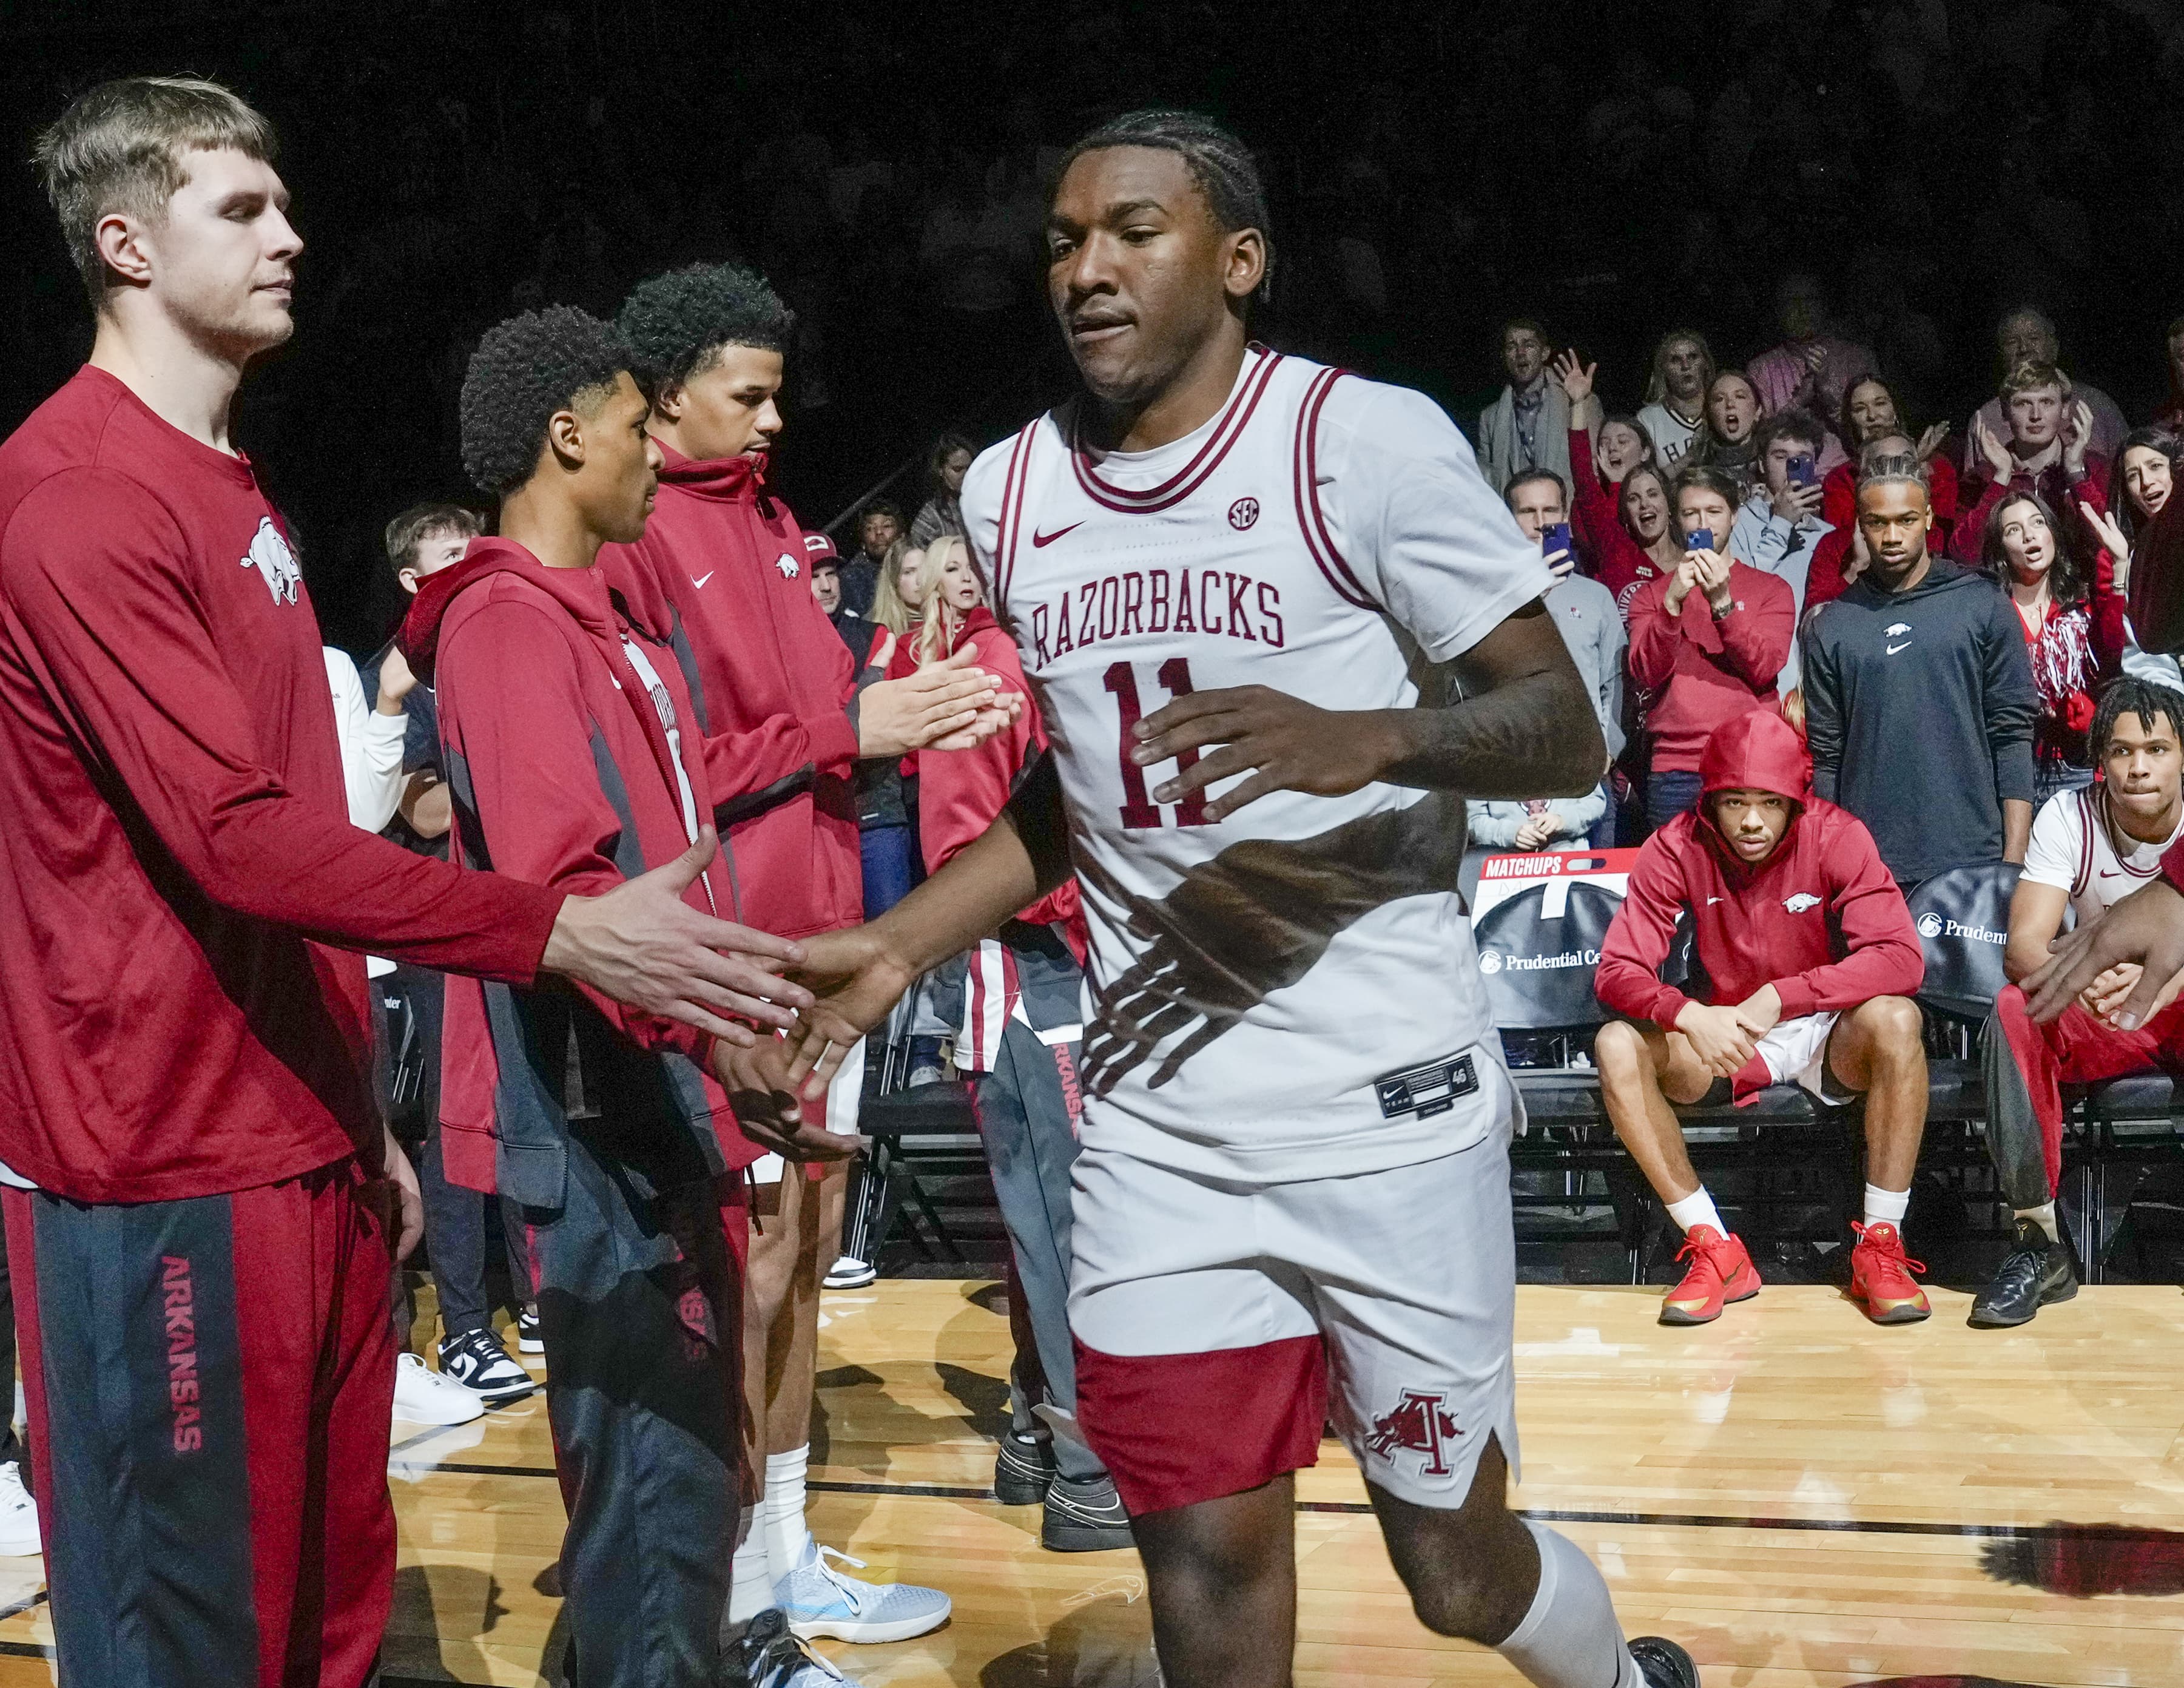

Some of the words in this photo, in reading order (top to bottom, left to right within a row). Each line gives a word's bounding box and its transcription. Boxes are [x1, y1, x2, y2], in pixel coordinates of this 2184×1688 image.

[1230, 499, 1258, 528] SEC
[1032, 567, 1285, 672] RAZORBACKS
[1102, 657, 1221, 829] 11
[1485, 856, 1562, 877] MATCHUPS
[1505, 950, 1583, 970] Prudential
[161, 1255, 203, 1452] ARKANSAS
